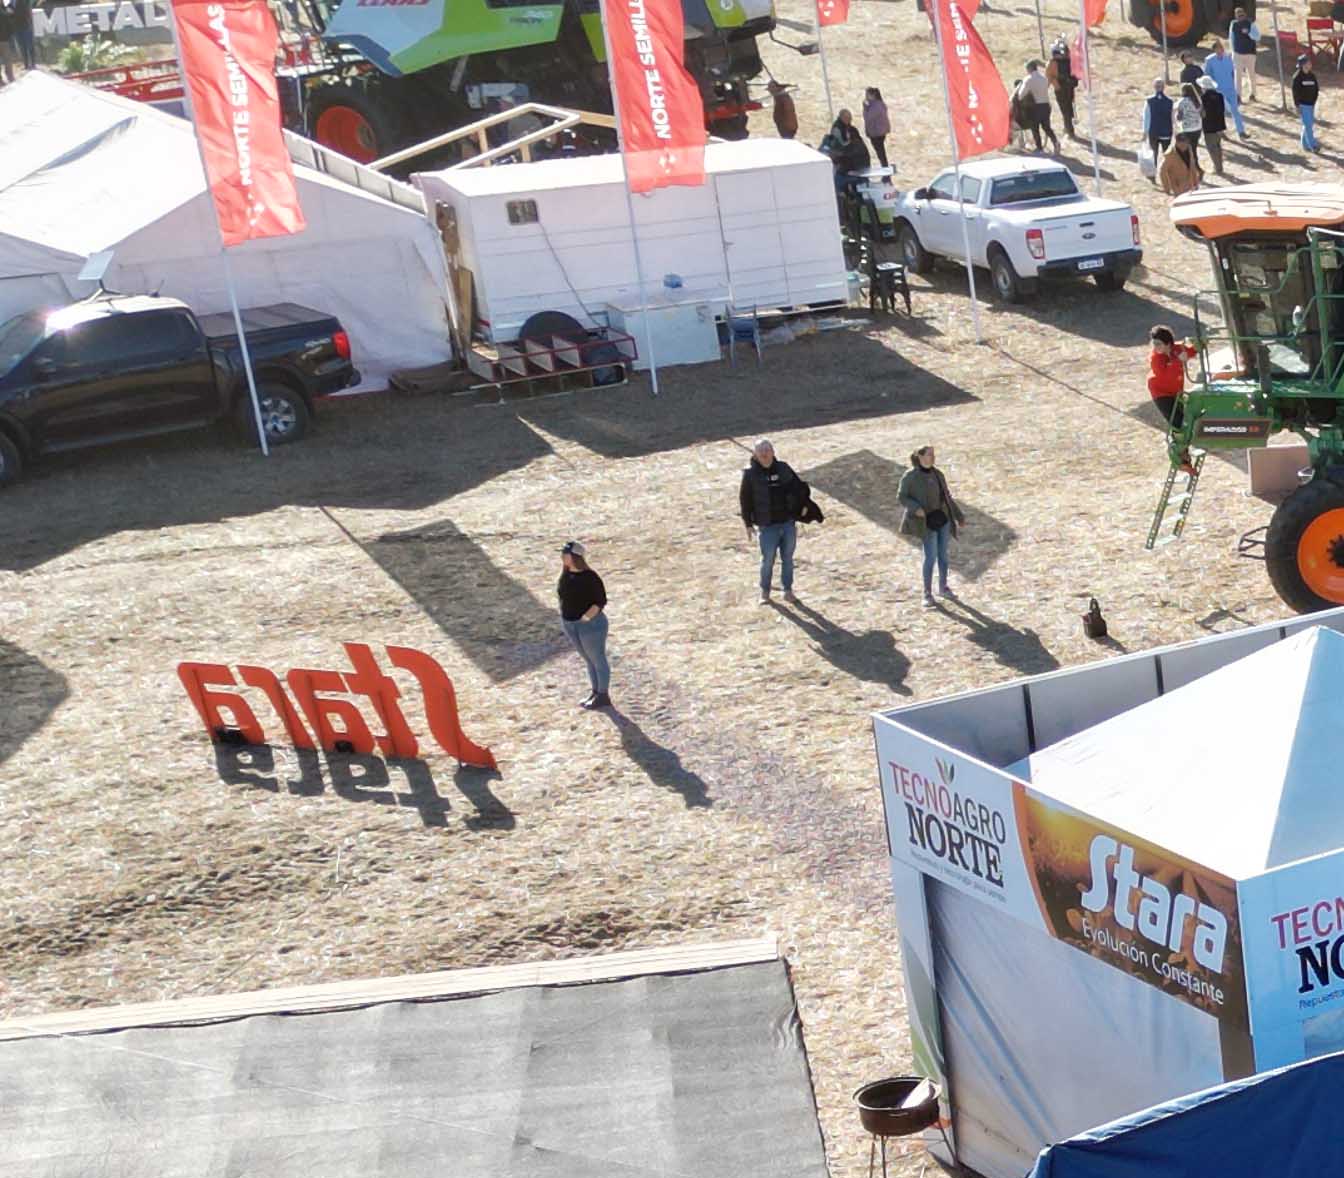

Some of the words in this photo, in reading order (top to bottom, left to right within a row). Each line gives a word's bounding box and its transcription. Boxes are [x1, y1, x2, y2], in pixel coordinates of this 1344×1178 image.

[645, 69, 672, 139] NORTE
[233, 110, 252, 185] NORTE
[889, 760, 1006, 845] TECNOAGRO
[903, 801, 1004, 888] NORTE
[1080, 833, 1227, 975] Stara
[1081, 916, 1149, 968] Evolución
[1152, 951, 1225, 1006] Constante
